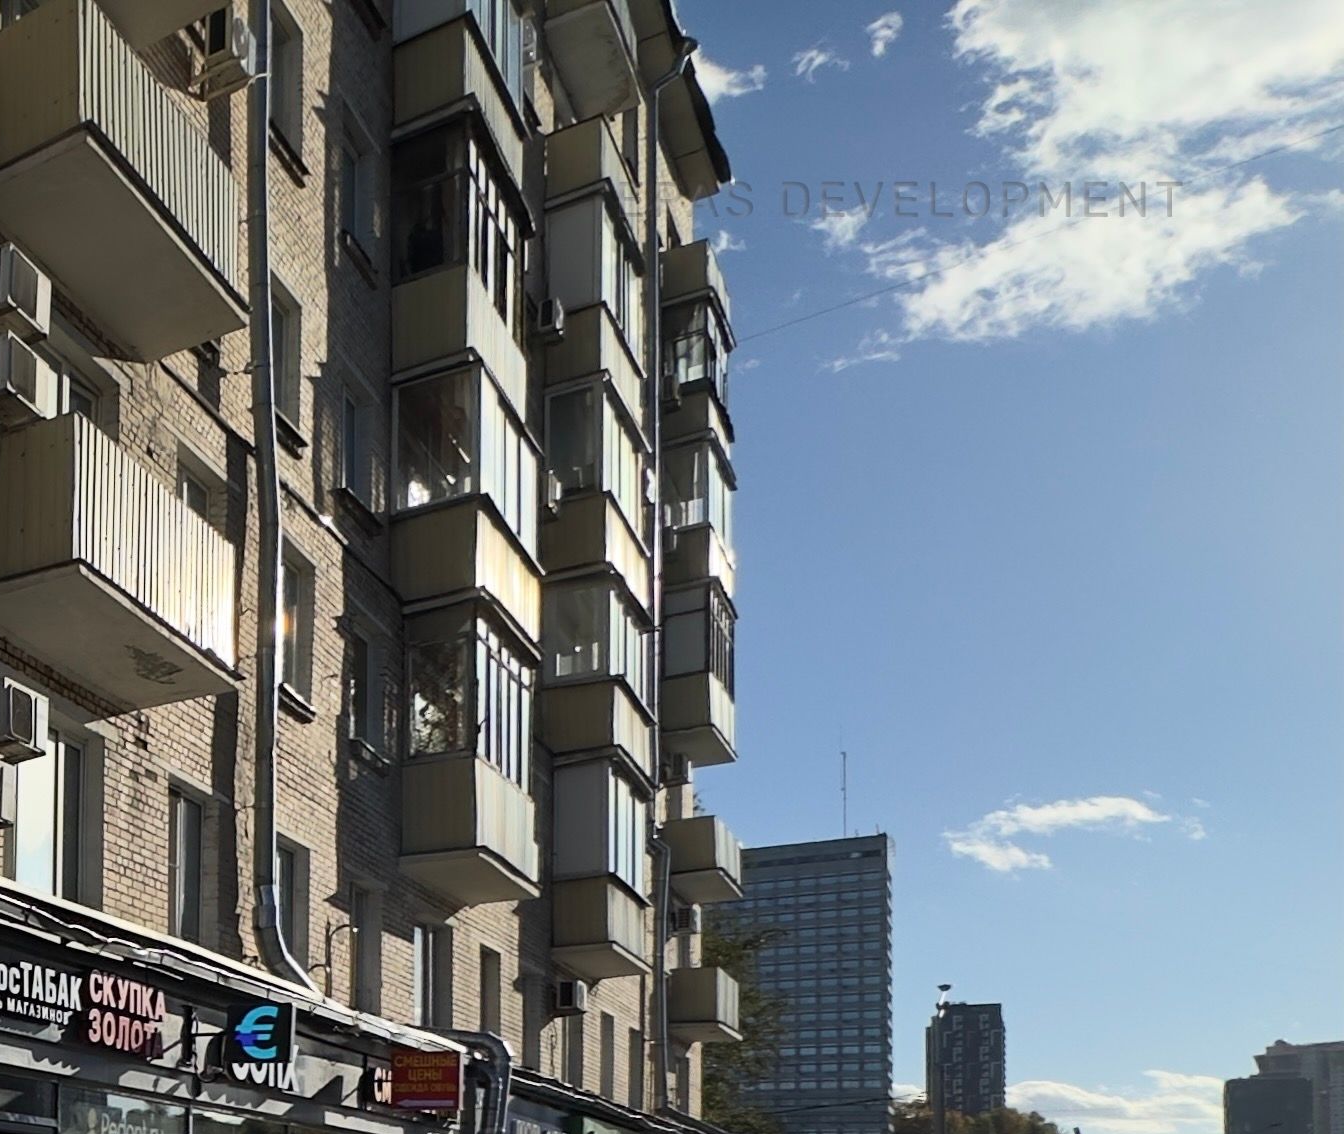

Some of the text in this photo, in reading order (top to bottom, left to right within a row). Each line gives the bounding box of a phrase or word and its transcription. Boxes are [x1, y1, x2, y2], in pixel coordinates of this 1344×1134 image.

[89, 971, 165, 1022] СКУПКА
[393, 1054, 458, 1068] СМЕШНЫЕ
[407, 1067, 443, 1082] ЦЕНЫ
